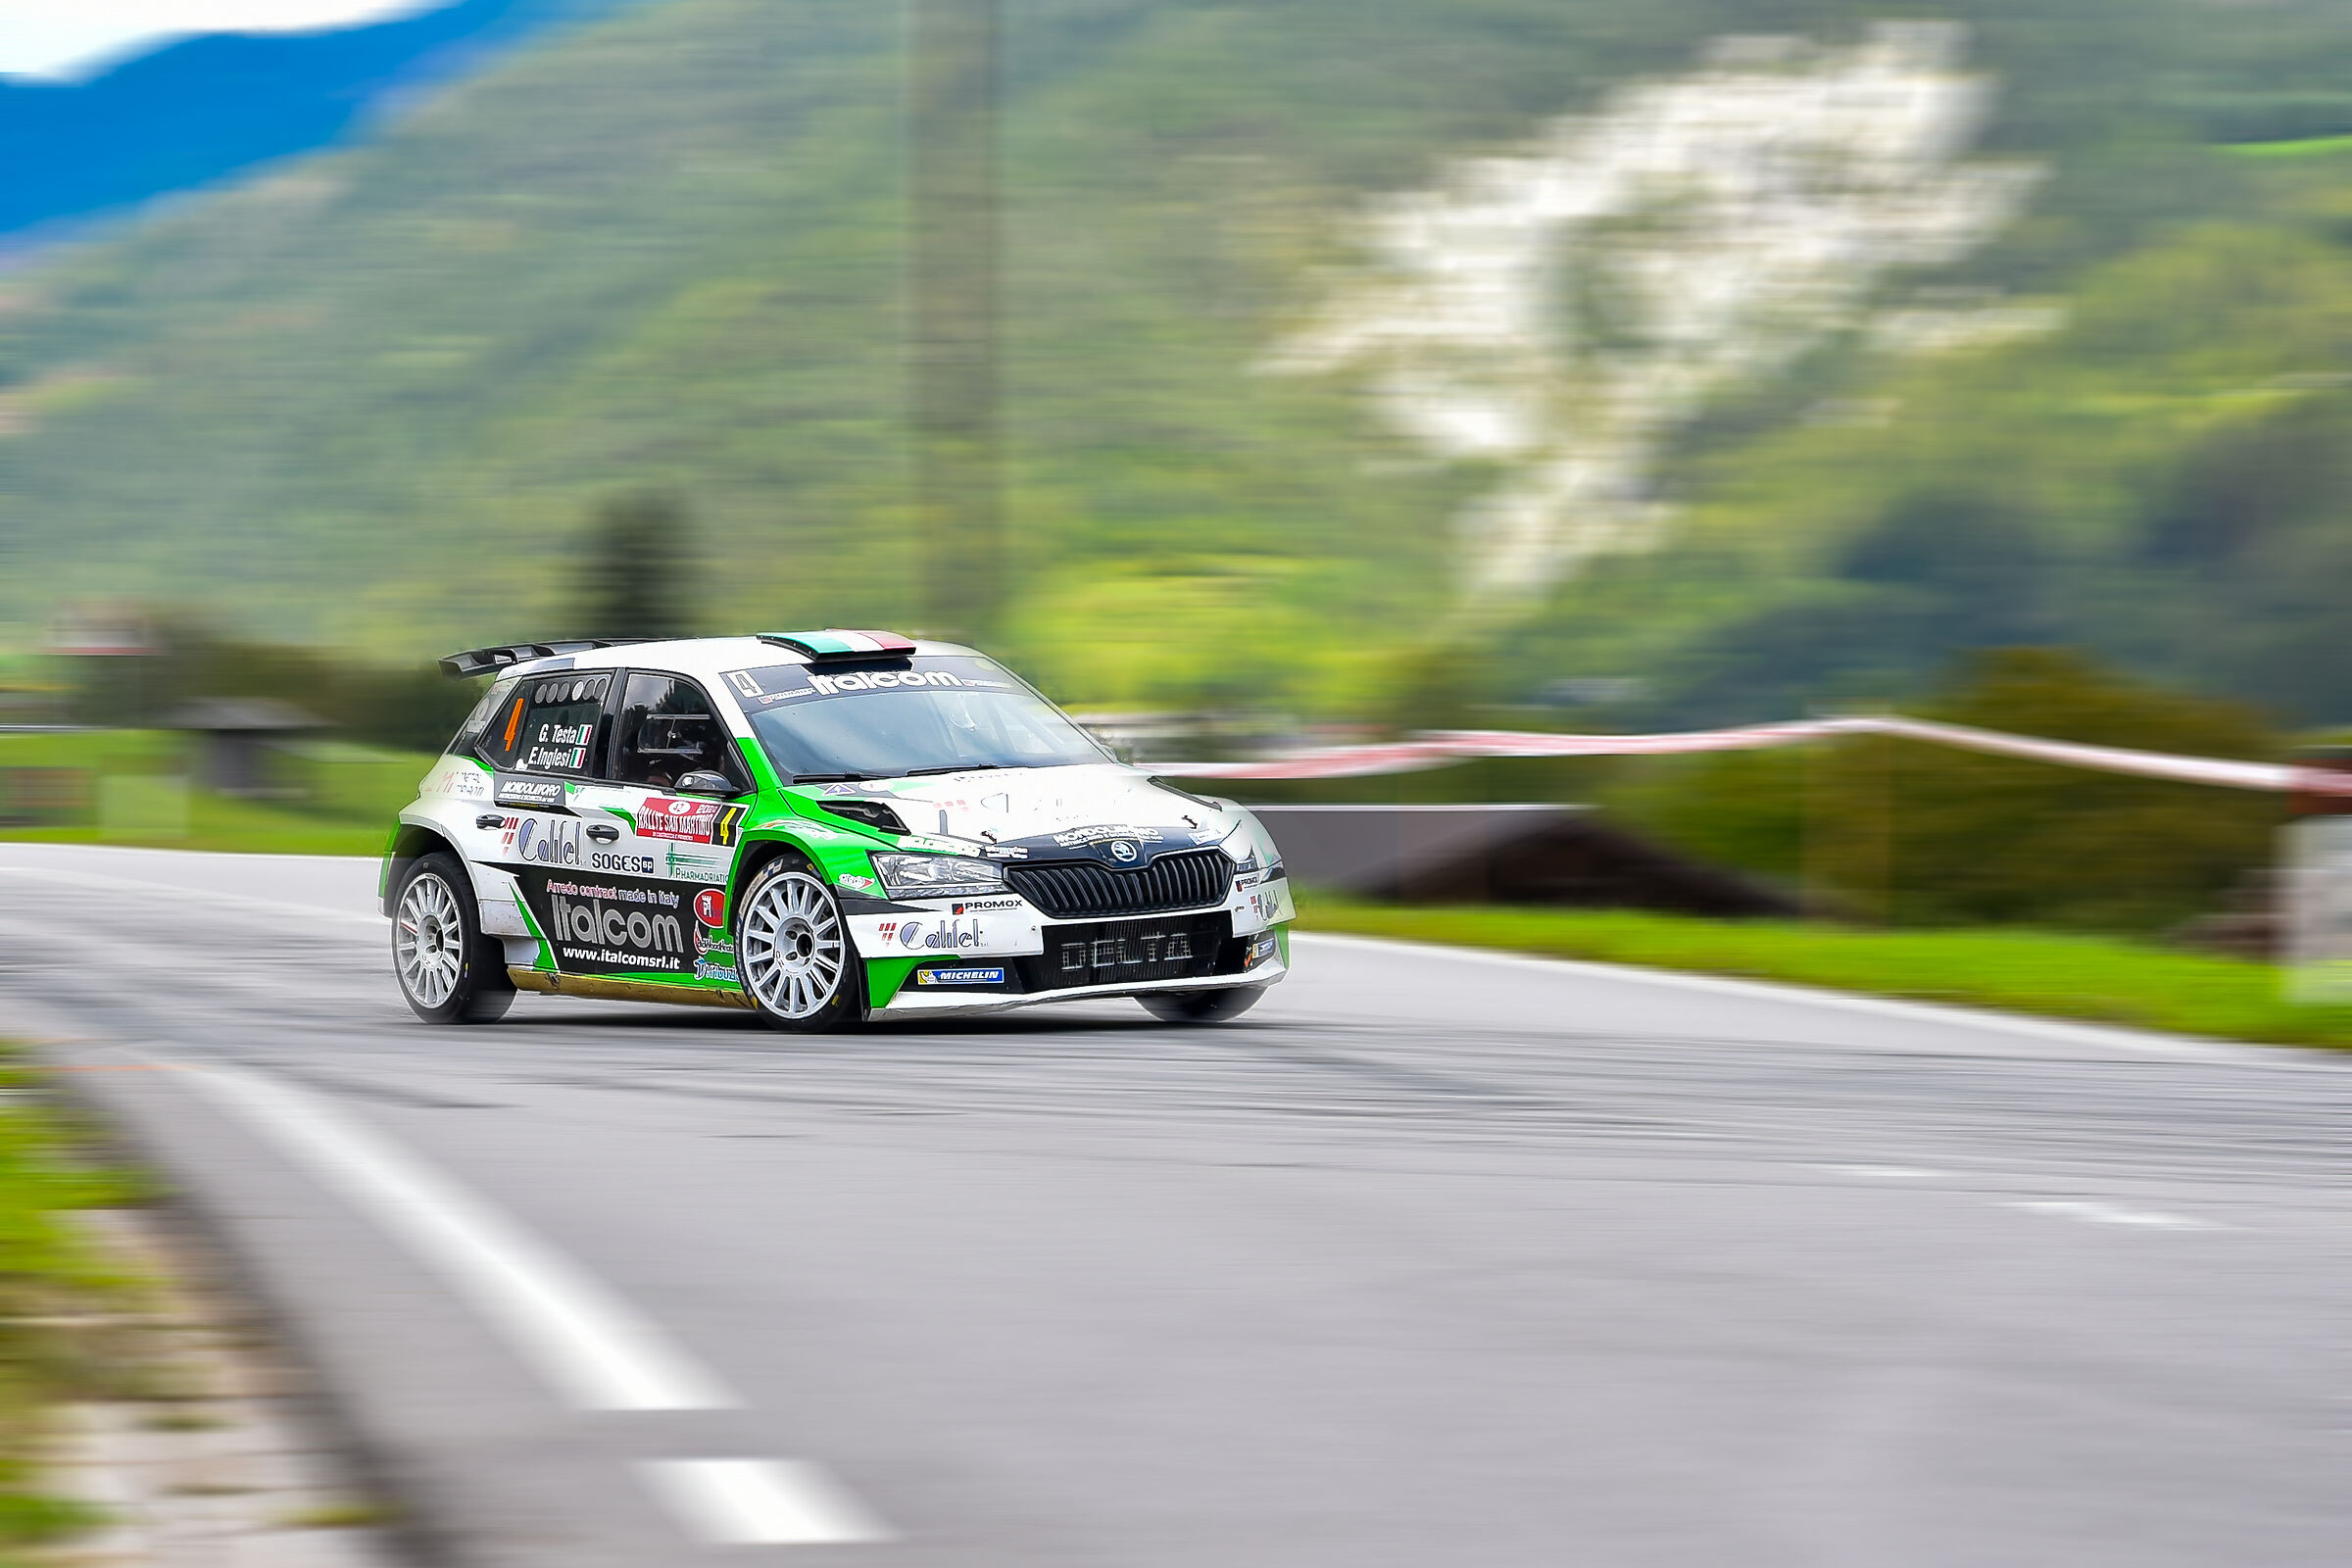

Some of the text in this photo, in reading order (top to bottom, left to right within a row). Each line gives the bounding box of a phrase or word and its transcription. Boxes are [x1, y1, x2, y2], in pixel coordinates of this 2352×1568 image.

[504, 697, 524, 752] 4
[538, 723, 577, 744] G. Testa
[638, 806, 663, 831] RALLYE
[664, 814, 678, 833] SAN
[679, 813, 714, 836] MARTINO
[719, 807, 737, 845] 4
[591, 852, 641, 872] SOGES
[546, 879, 680, 909] Arredo contract made in Italy
[964, 899, 1023, 909] PROMOX
[551, 894, 684, 954] Italcom
[563, 947, 680, 969] www.italcomsrl.it
[940, 969, 1000, 980] MICHELIN
